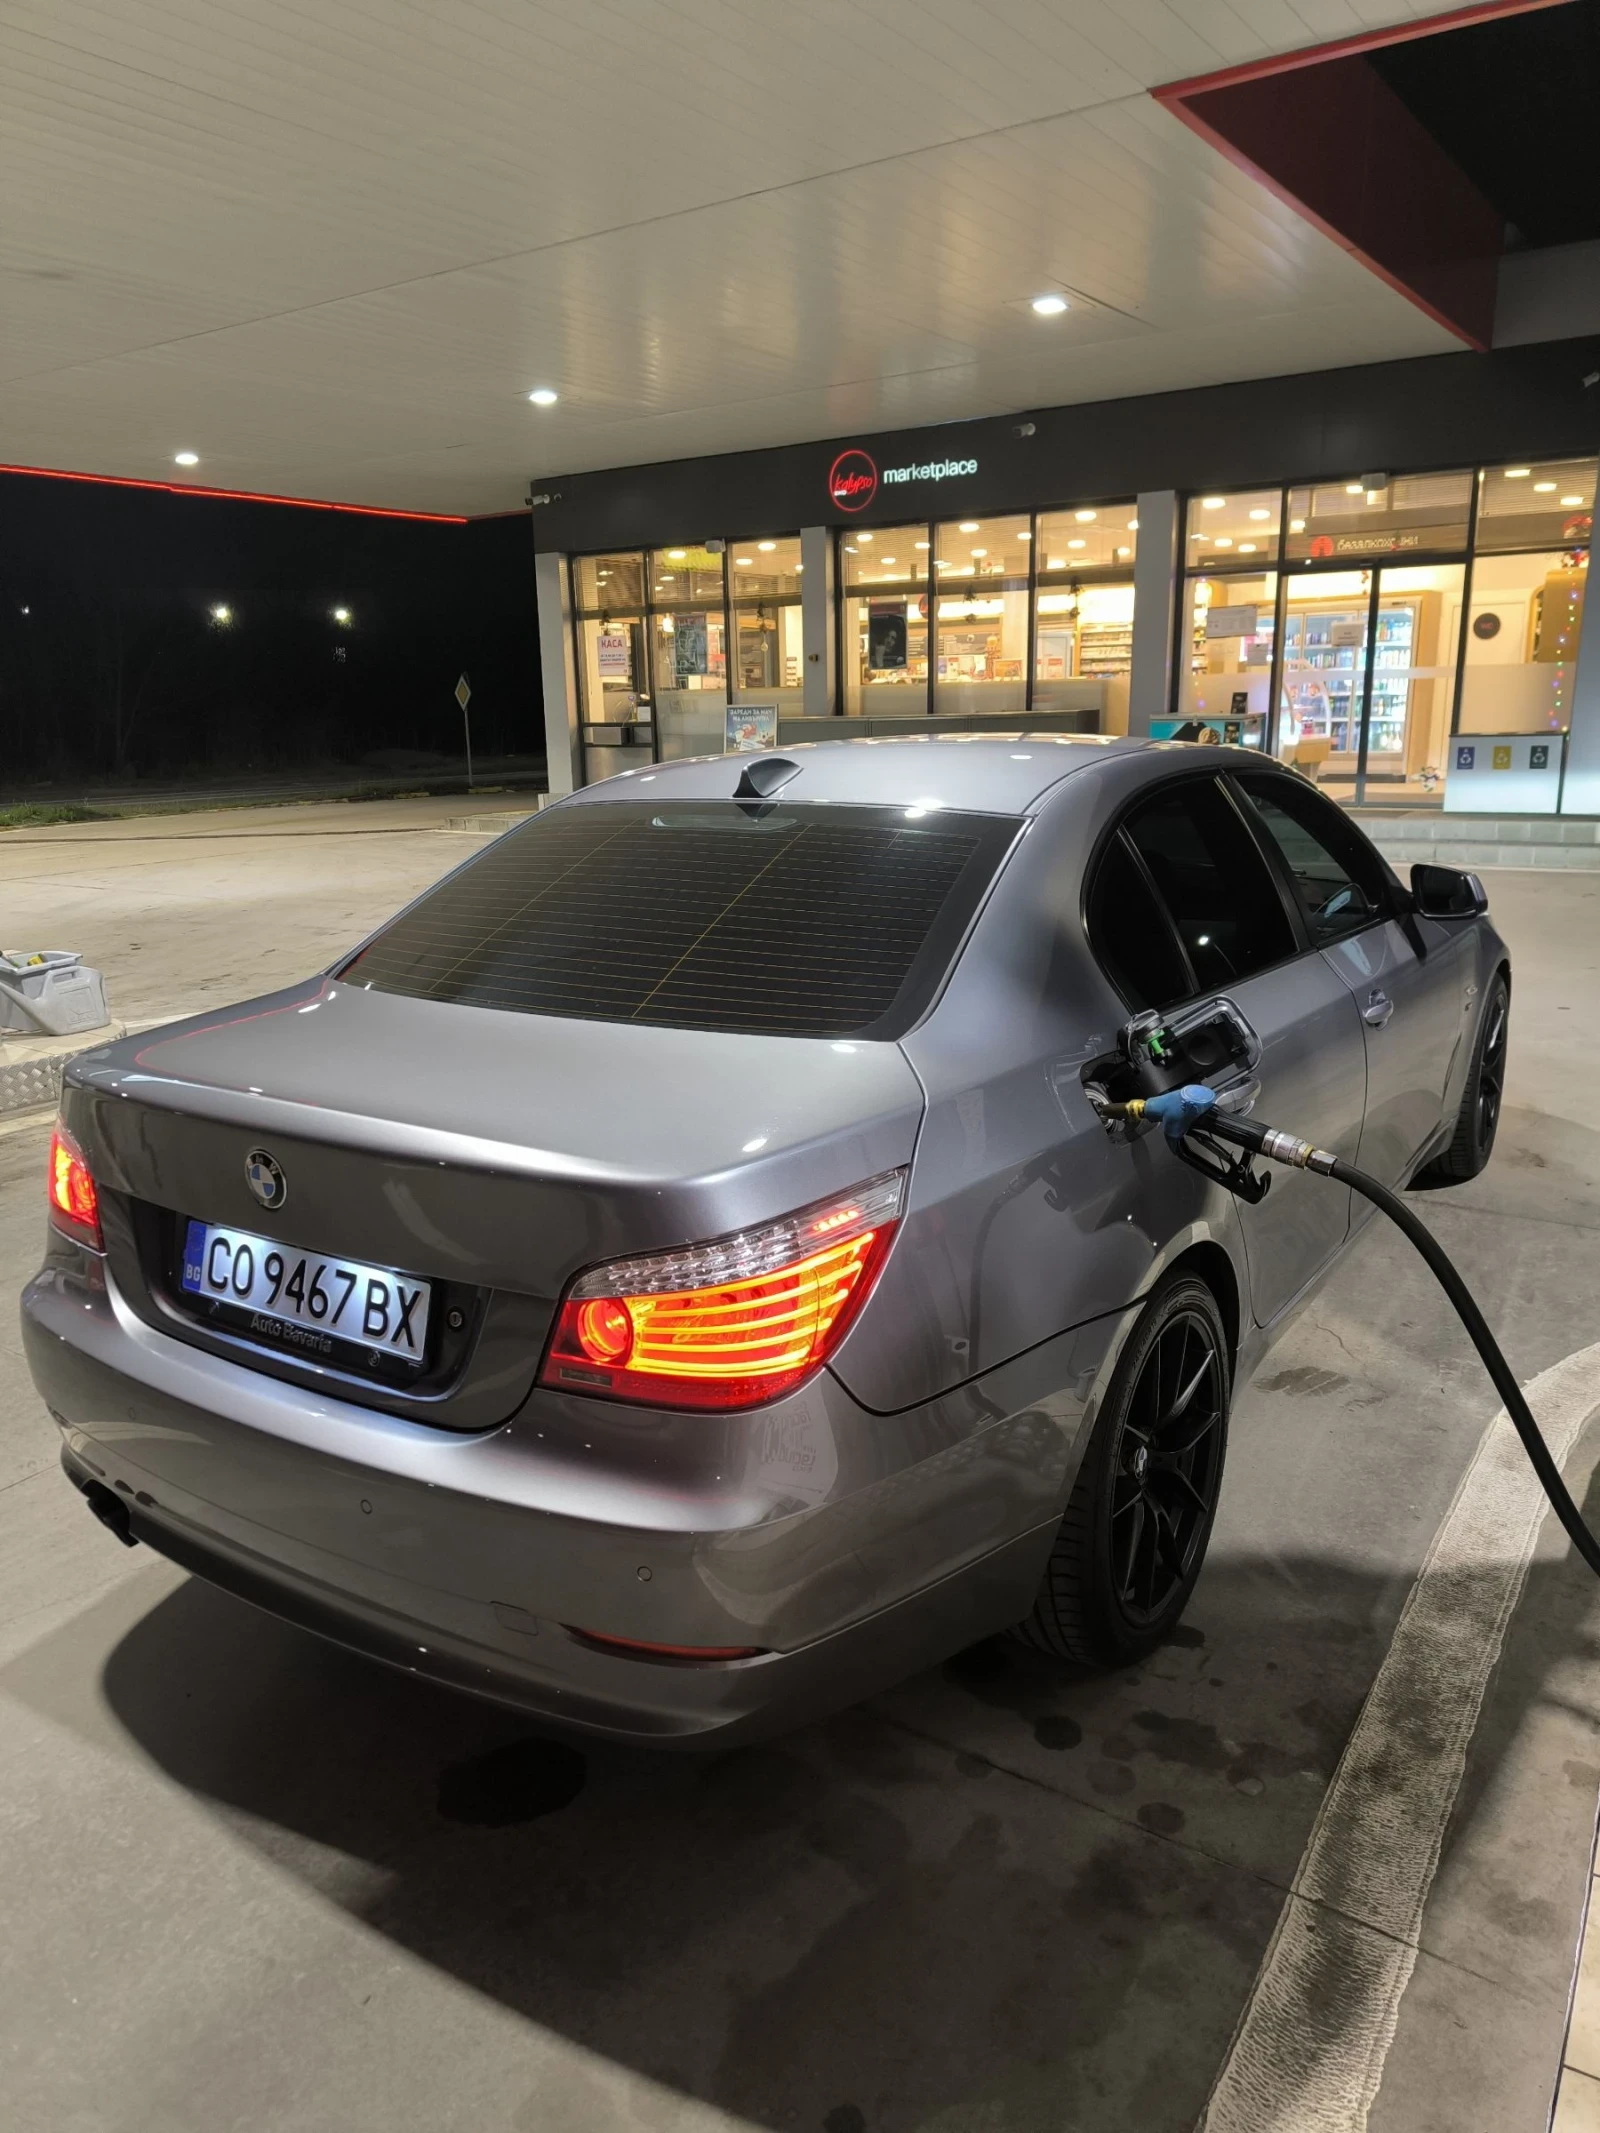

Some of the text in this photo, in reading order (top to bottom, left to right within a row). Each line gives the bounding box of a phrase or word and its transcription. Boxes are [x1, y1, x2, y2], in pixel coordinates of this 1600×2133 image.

[834, 471, 874, 496] kalypso
[883, 459, 978, 484] marketplace
[601, 639, 623, 649] КАСА
[186, 1265, 201, 1281] BG
[207, 1236, 421, 1349] CO 9467 BX
[250, 1313, 332, 1353] Auto Bavaria
